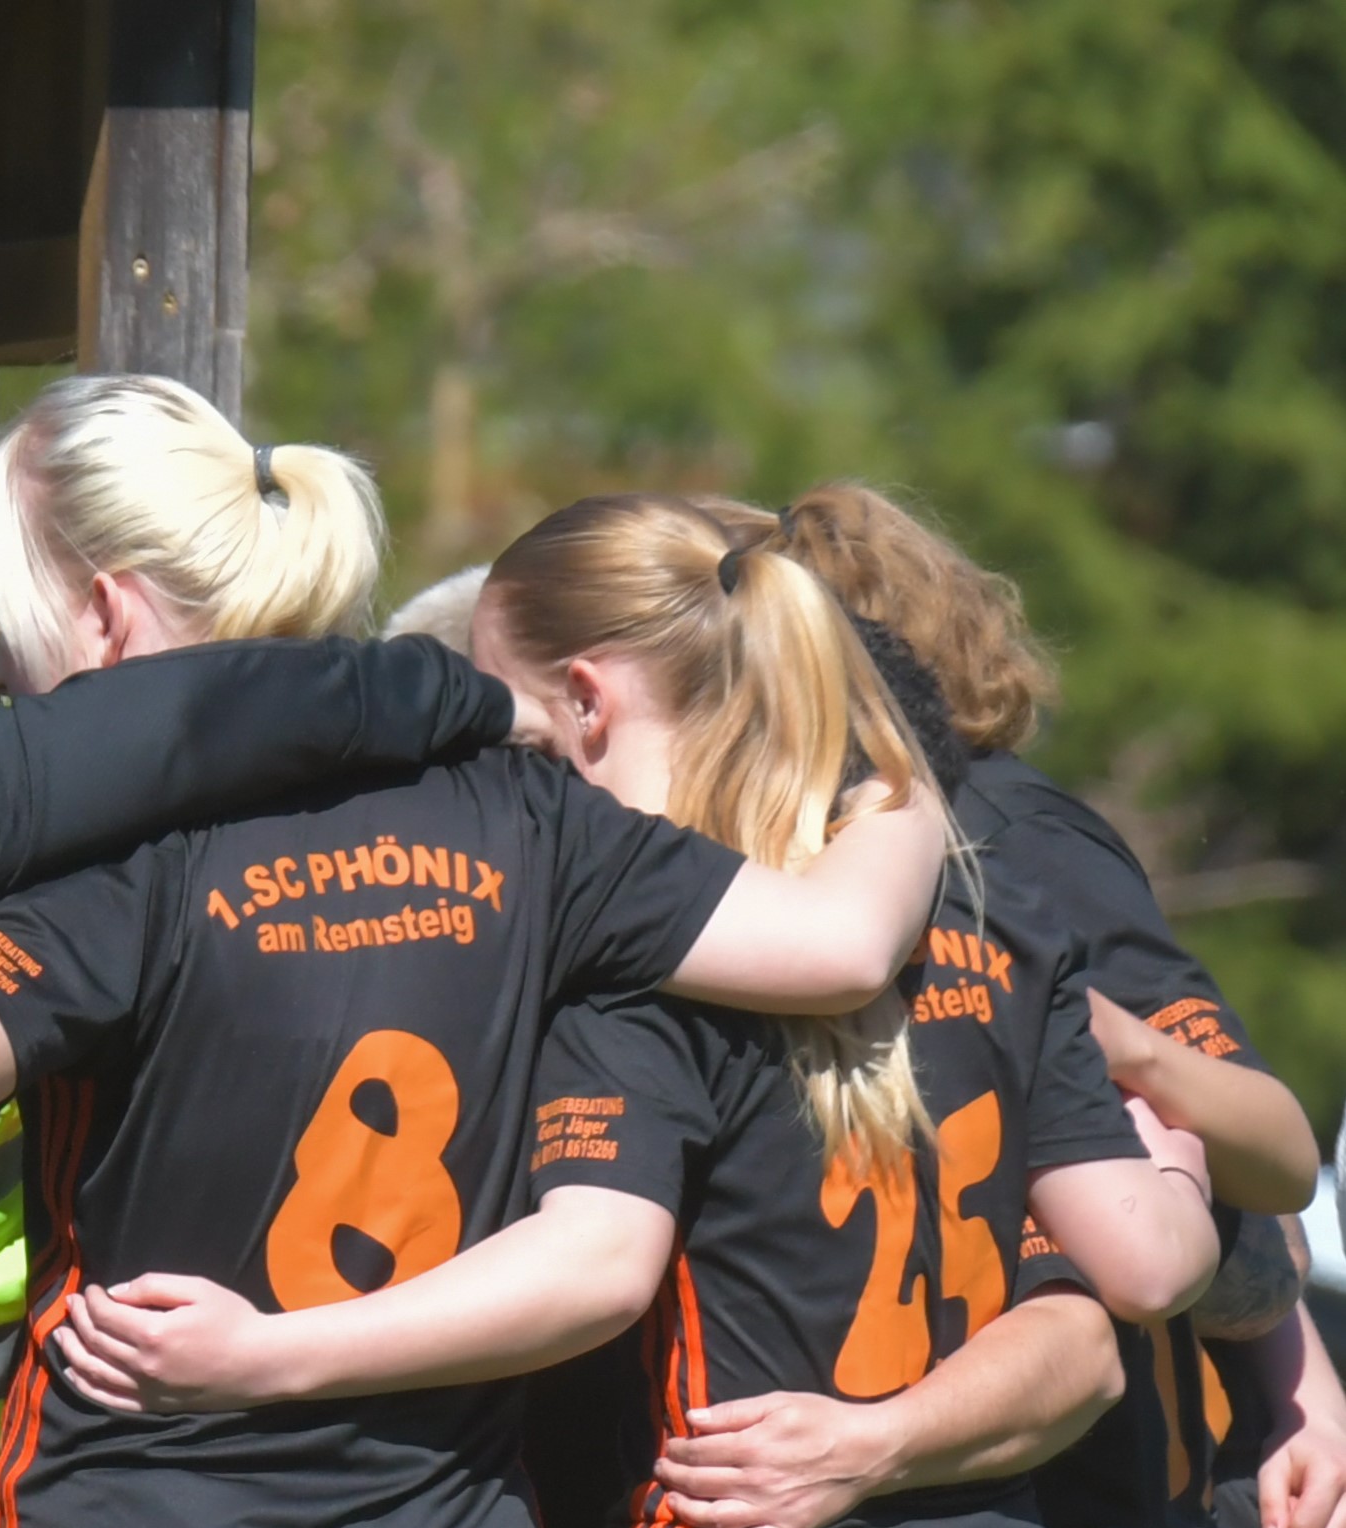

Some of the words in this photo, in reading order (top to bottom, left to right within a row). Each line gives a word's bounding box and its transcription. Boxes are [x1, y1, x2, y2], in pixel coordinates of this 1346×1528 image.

[206, 856, 307, 931] 1.SC
[306, 834, 505, 914] PHÖNIX
[256, 922, 307, 953] am
[311, 896, 476, 946] Rennsteig
[266, 1029, 463, 1313] 8
[820, 1089, 1007, 1399] 25
